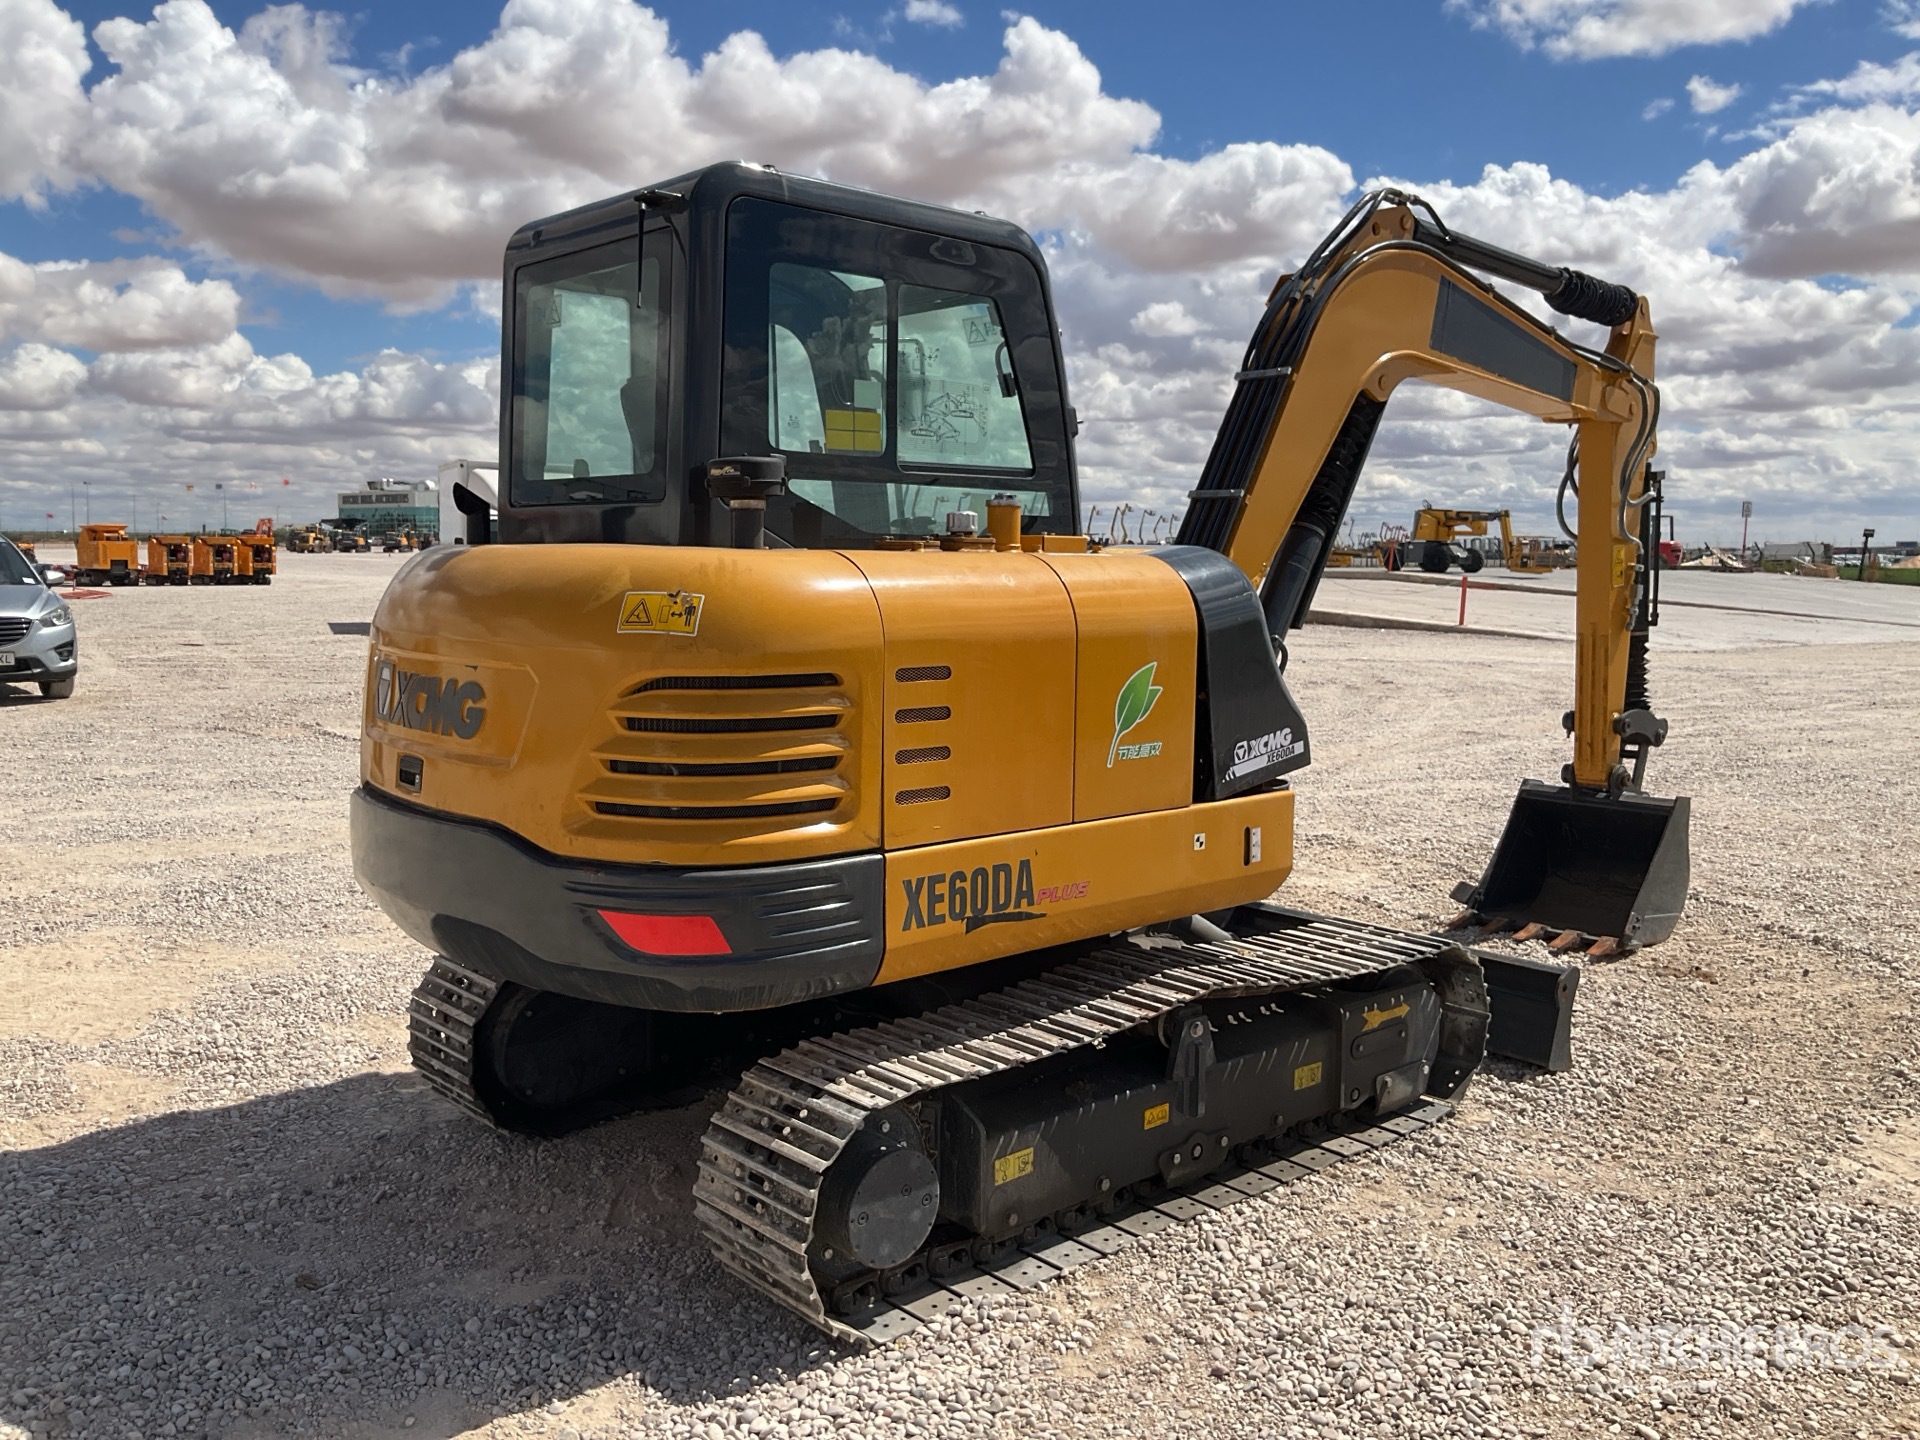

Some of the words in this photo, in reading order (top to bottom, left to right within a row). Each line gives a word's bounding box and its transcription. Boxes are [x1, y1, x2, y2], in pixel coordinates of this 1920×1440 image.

[390, 669, 487, 740] XCMG
[1248, 727, 1292, 759] XCMG
[1266, 745, 1295, 764] XE60DA
[902, 859, 1034, 931] XE60DA
[1036, 881, 1090, 905] PLUS
